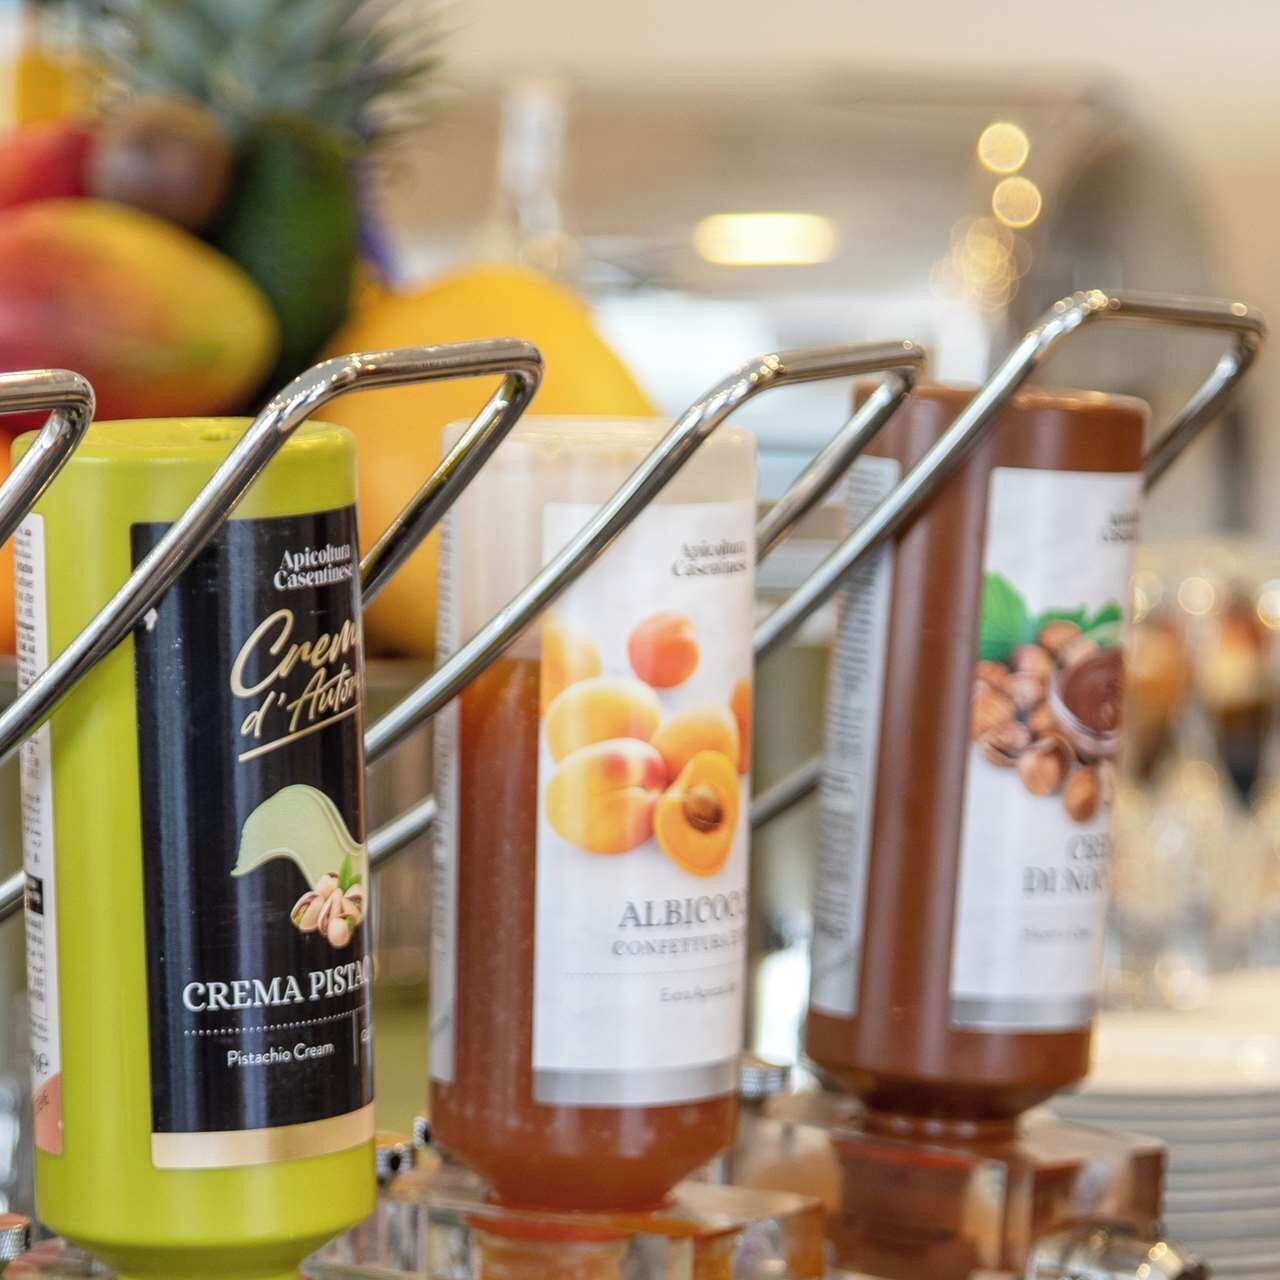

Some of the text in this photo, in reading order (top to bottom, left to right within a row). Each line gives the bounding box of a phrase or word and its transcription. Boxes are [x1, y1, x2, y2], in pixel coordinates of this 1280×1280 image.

[280, 543, 351, 570] Apicoltura
[182, 975, 305, 1012] CREMA
[227, 1042, 335, 1068] Pistachio Cream
